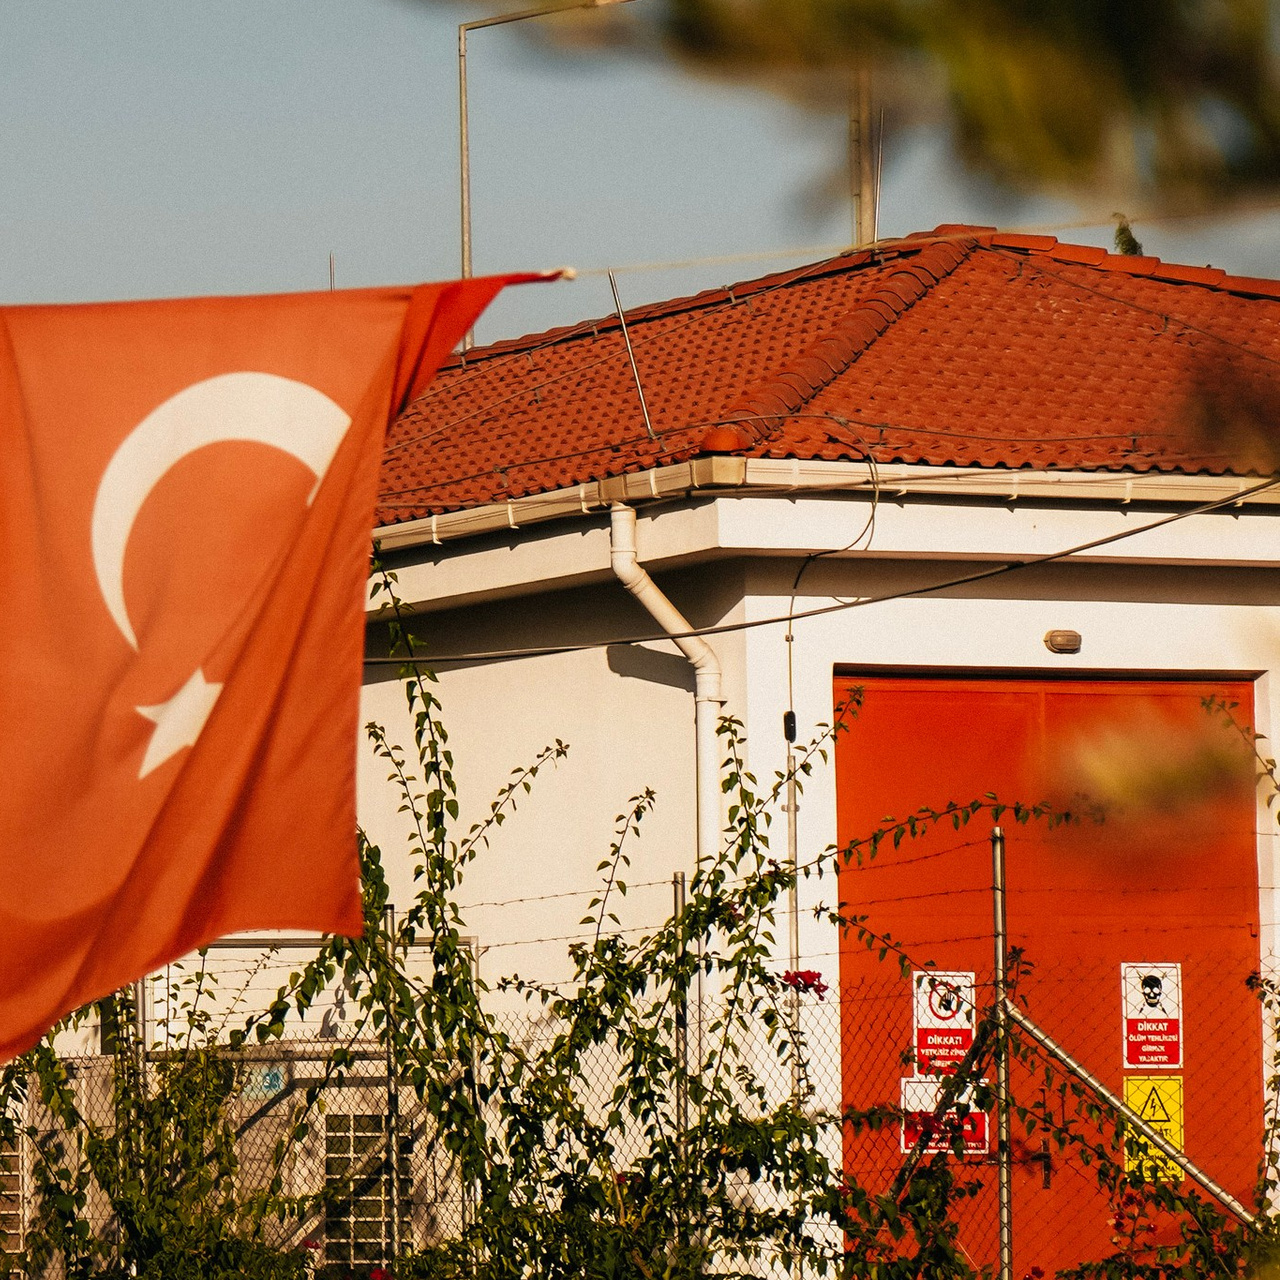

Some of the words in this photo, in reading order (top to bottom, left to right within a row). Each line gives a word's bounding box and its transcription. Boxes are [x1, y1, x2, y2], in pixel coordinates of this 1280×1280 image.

[1137, 1021, 1168, 1031] DİKKAT
[1128, 1033, 1147, 1042] ÖLÜM
[1141, 1044, 1165, 1052] GİRMEK
